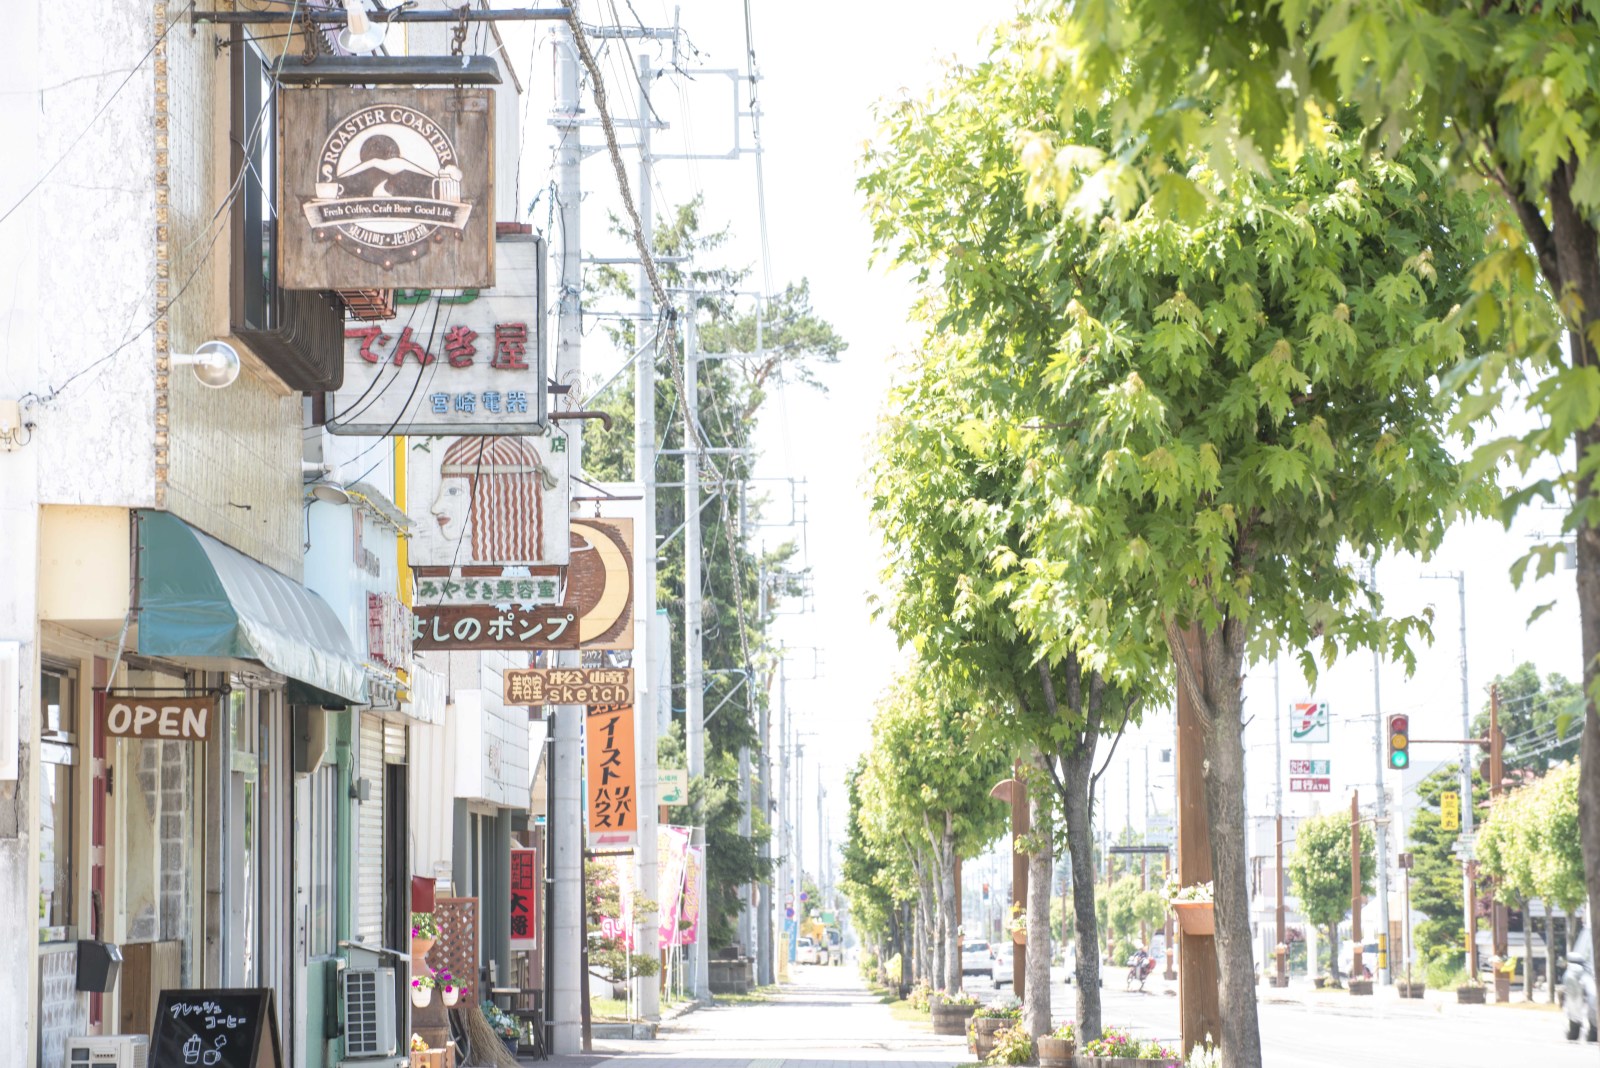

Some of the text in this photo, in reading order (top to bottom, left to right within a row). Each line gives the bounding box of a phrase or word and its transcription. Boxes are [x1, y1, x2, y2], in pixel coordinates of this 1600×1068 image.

[324, 109, 452, 165] ROASTER COASTER
[323, 207, 344, 217] Fresh
[373, 203, 392, 213] Craft
[394, 204, 412, 213] Beer
[414, 205, 435, 215] Good
[437, 207, 452, 217] Life
[345, 322, 529, 370] でんき屋
[430, 391, 528, 414] 宮崎電器
[420, 579, 556, 600] みやざき美容室
[512, 674, 543, 700] 美容室
[549, 686, 626, 702] sketch
[107, 703, 208, 738] OPEN
[600, 716, 621, 786] イースト
[595, 787, 611, 828] ハウス
[614, 785, 631, 827] リバー
[171, 1001, 222, 1019] フレッシュ
[205, 1015, 246, 1029] コーヒー
